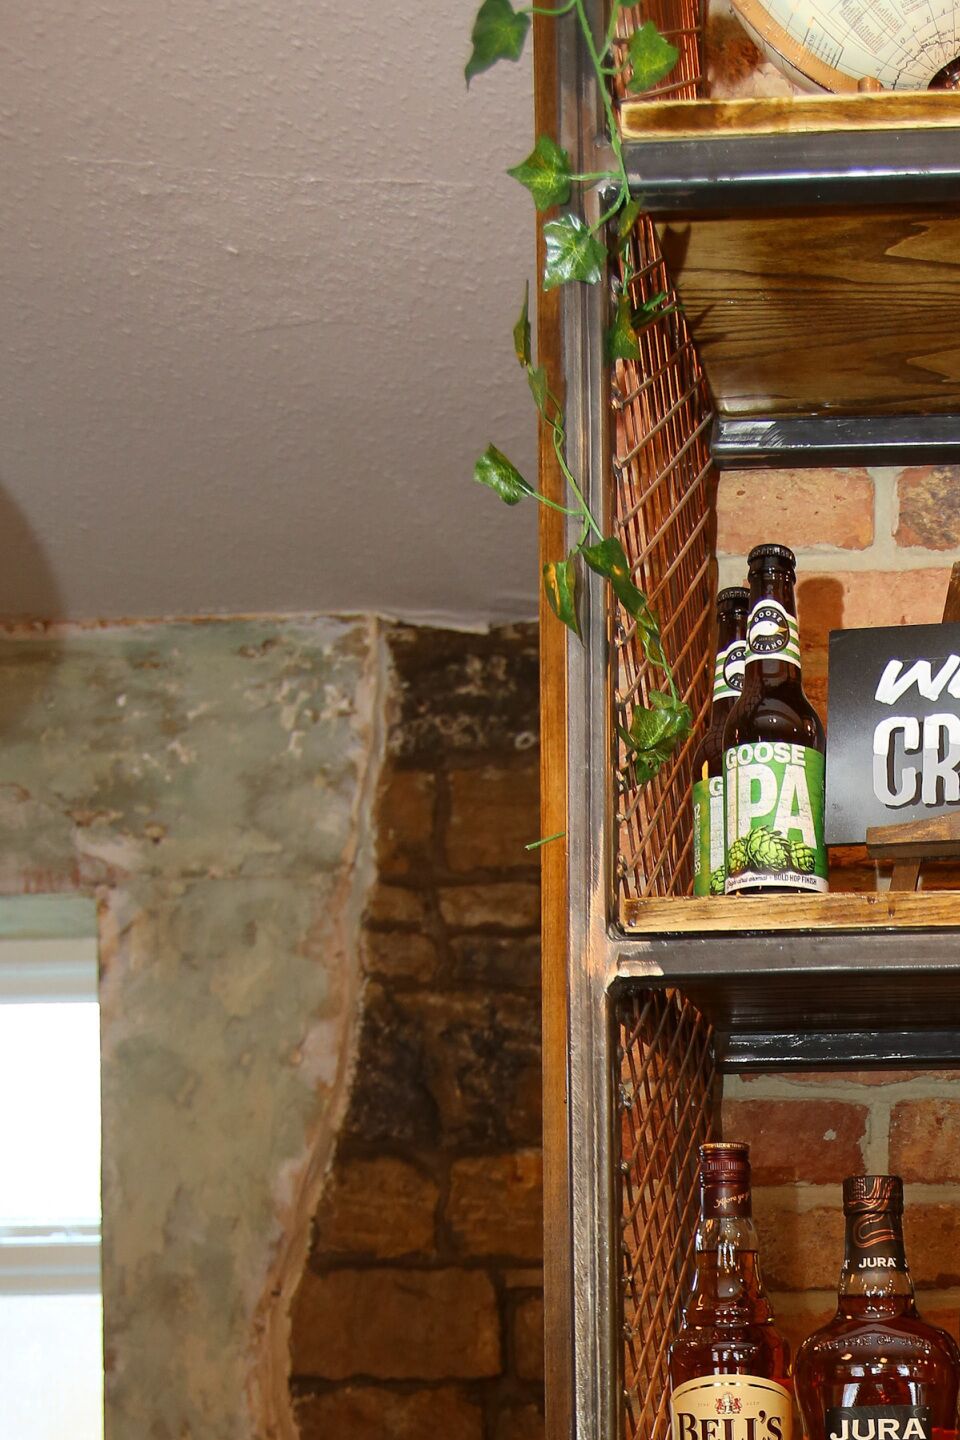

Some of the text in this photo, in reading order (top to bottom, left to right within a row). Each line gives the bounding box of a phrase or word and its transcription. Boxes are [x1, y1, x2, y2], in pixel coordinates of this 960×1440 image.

[754, 610, 783, 623] GOOSE
[726, 742, 805, 769] GOOSE
[727, 763, 817, 849] IPA
[859, 1257, 896, 1268] JURA
[829, 1418, 927, 1440] JURA
